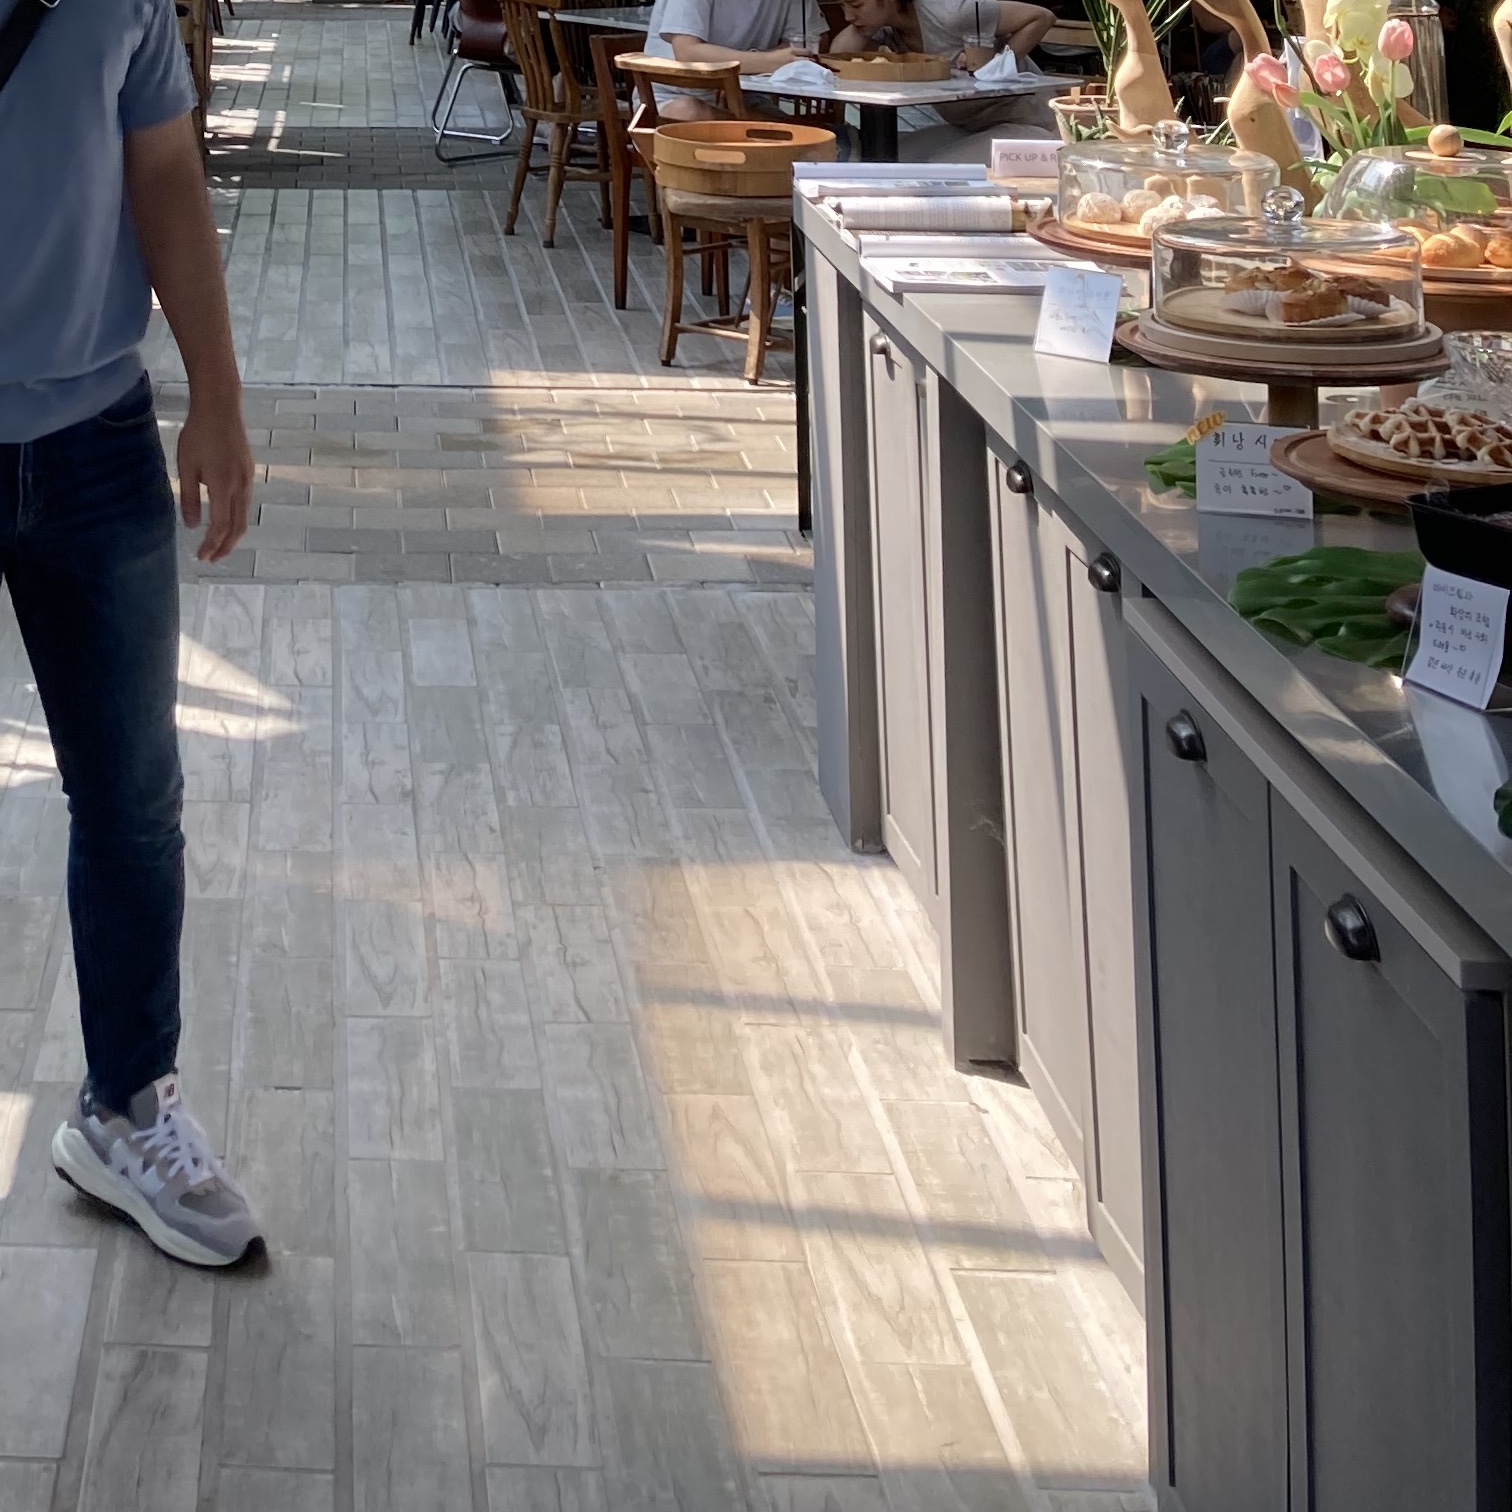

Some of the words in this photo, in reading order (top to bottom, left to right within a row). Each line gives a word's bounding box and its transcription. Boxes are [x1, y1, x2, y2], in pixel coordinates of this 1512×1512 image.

[999, 152, 1022, 163] PICK
[1024, 153, 1038, 163] UP
[1213, 431, 1267, 451] 휘낭시
